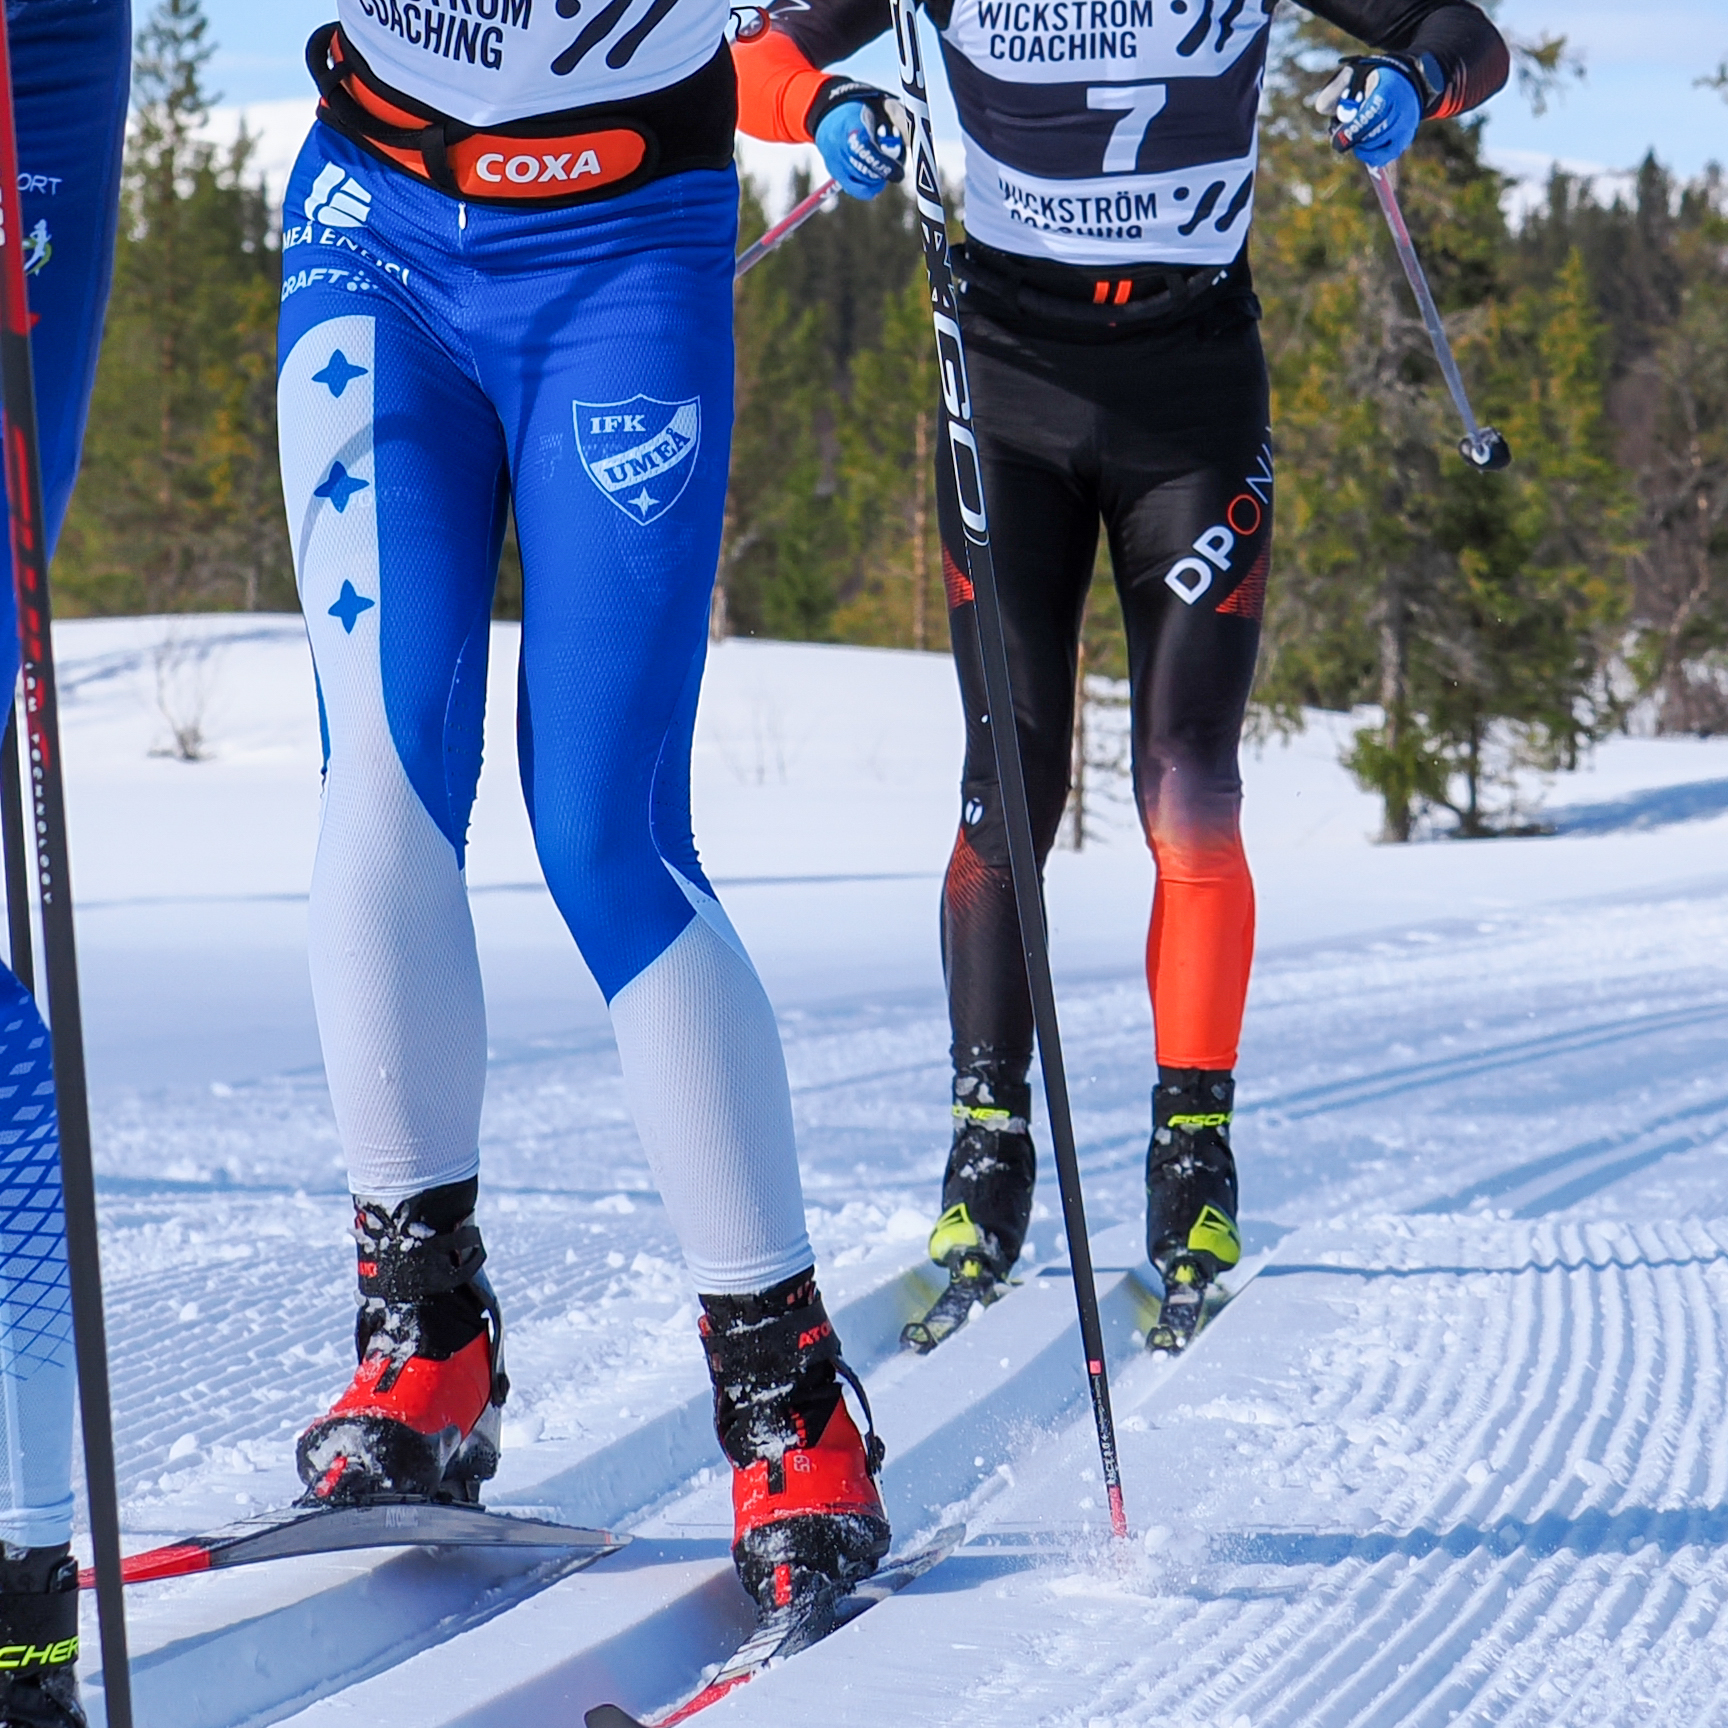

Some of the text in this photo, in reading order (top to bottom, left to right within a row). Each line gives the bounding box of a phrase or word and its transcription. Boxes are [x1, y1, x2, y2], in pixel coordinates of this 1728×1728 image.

[989, 30, 1138, 63] COACHING
[1087, 83, 1168, 174] 7
[475, 149, 602, 183] COXA
[999, 177, 1159, 225] WICKSTRÖM
[280, 268, 350, 303] CRAFT
[590, 413, 647, 435] IFK
[607, 426, 692, 485] UMEÅ
[30, 731, 54, 906] TECHNOLOGY
